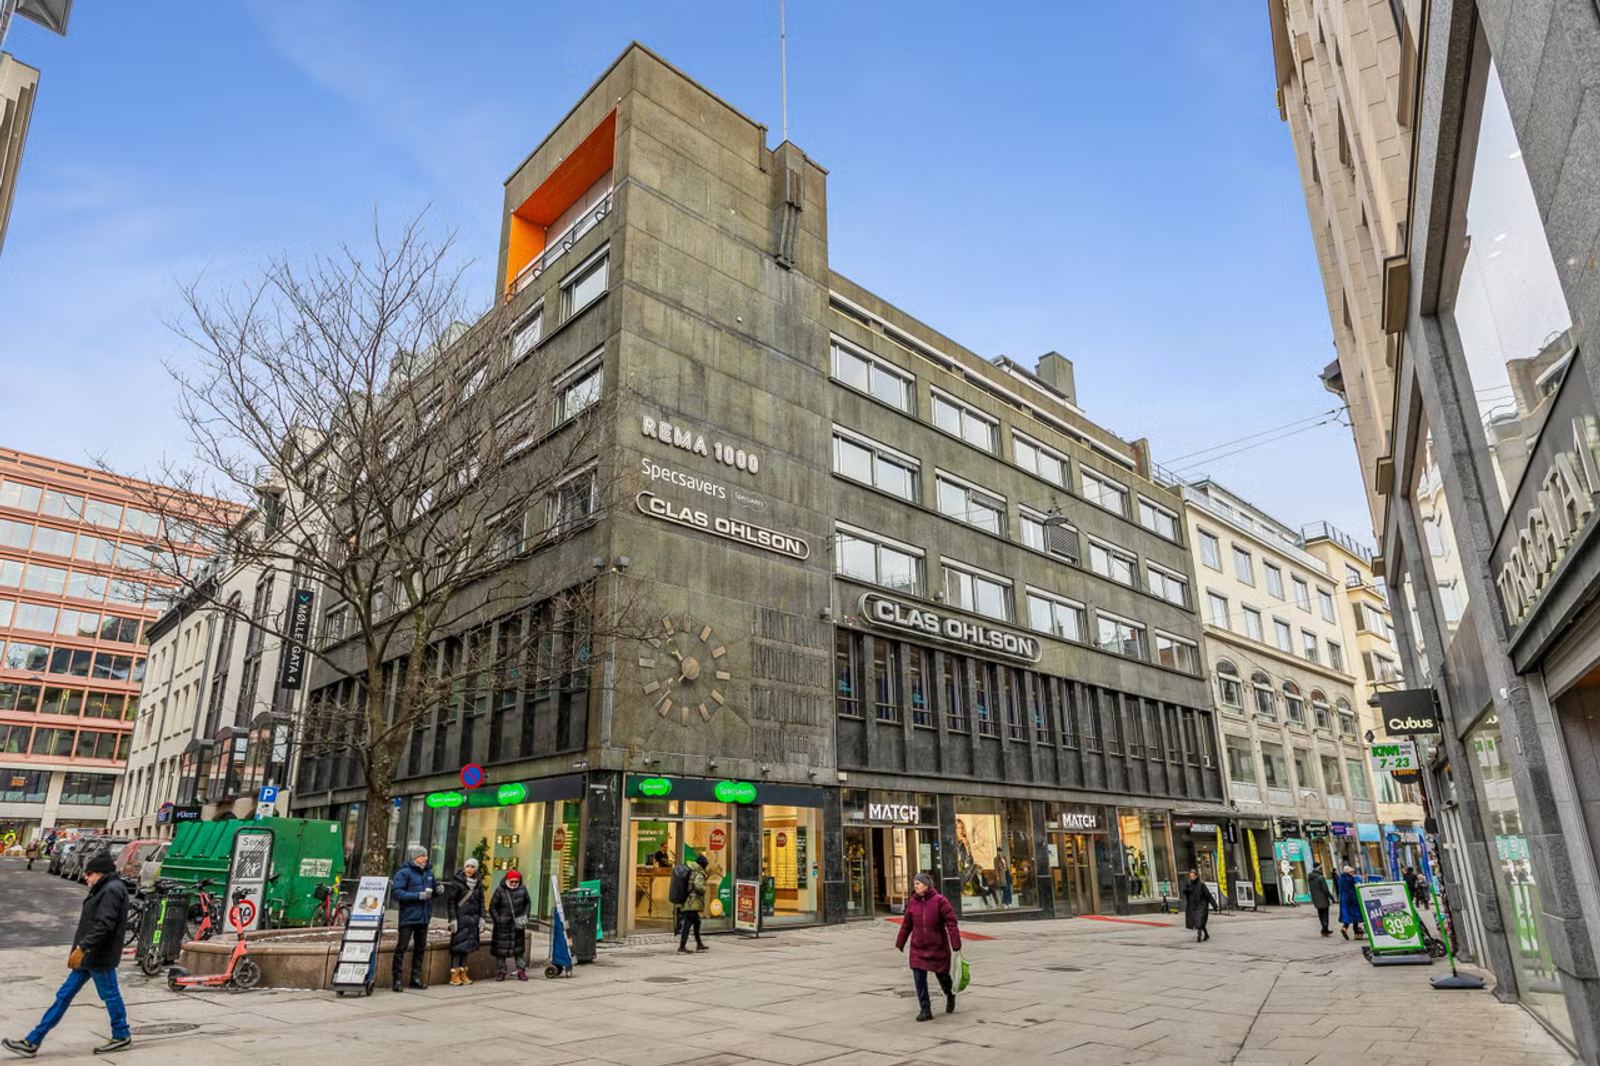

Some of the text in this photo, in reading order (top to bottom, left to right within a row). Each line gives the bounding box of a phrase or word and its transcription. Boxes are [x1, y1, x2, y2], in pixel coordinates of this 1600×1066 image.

[641, 415, 759, 474] REMA 1000
[641, 457, 726, 499] Specsavers
[649, 497, 801, 555] CLAS OHLSON
[1497, 452, 1591, 627] TORGGATA
[287, 603, 308, 675] MØLLEGATA
[873, 600, 1033, 656] CLAS OHLSON
[1389, 716, 1434, 730] Cubus
[1371, 744, 1400, 757] KIWI
[262, 788, 274, 800] P
[868, 803, 919, 822] MATCH
[1062, 813, 1096, 828] MATCH
[1386, 918, 1405, 934] 39
